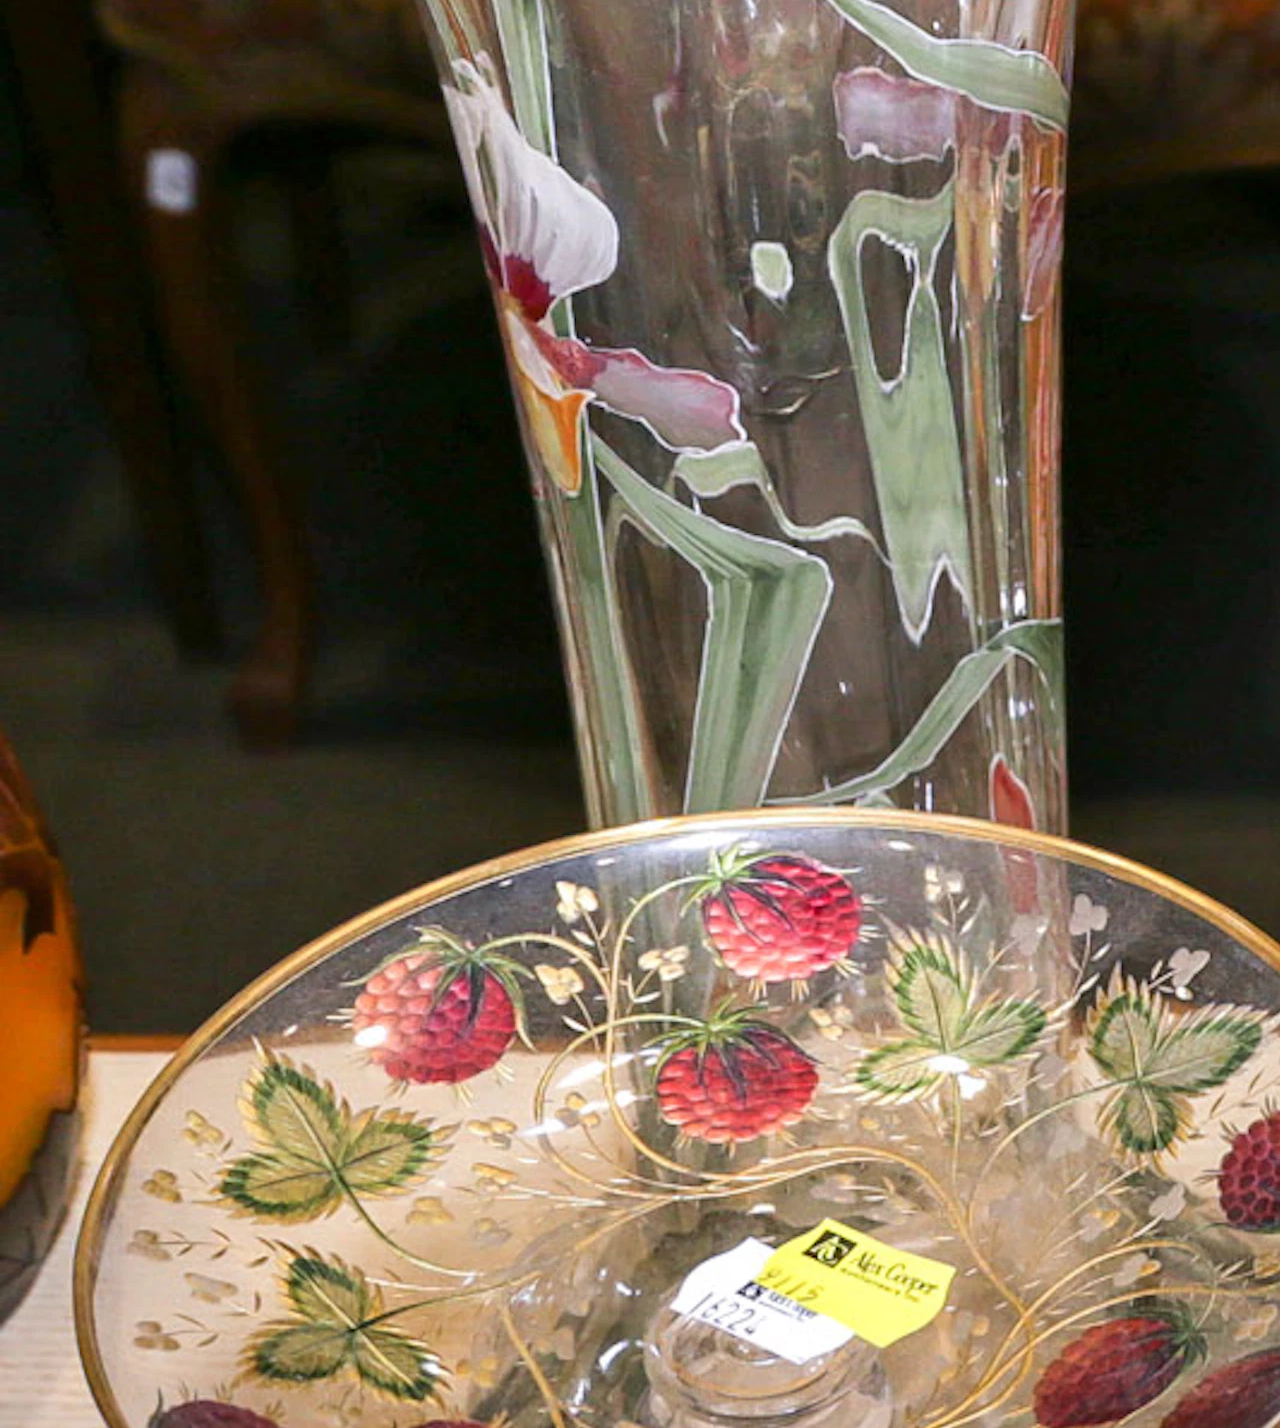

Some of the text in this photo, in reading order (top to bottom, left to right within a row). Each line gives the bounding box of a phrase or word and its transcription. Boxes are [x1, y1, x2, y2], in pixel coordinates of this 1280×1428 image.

[850, 1251, 883, 1275] Alex
[886, 1263, 938, 1295] Cooper
[688, 1293, 766, 1336] 16224
